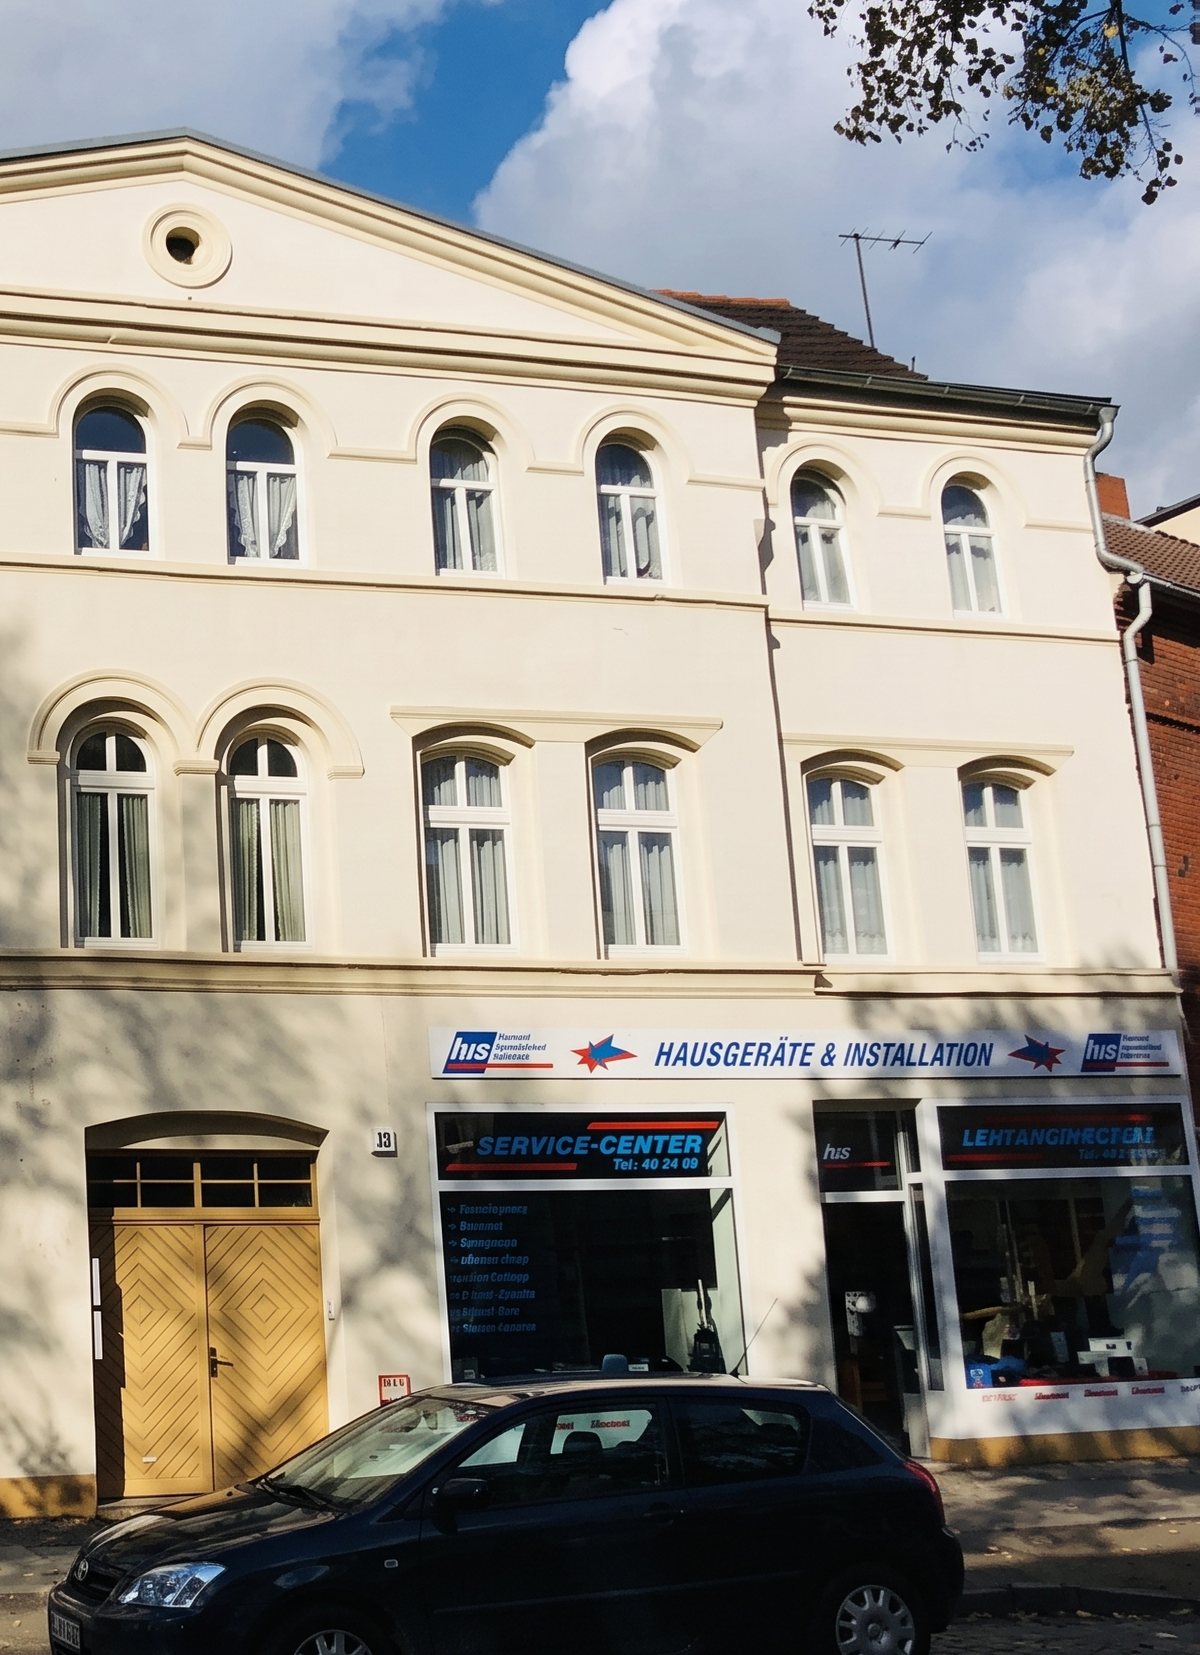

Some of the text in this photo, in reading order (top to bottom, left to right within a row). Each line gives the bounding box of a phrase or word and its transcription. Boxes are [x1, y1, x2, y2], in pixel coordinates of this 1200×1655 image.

[654, 1036, 994, 1067] HAUSGERÄTE & INSTALLATION
[476, 1134, 703, 1156] SERVICE-CENTER
[823, 1143, 851, 1160] his
[613, 1157, 699, 1171] Tel: 40 24 09
